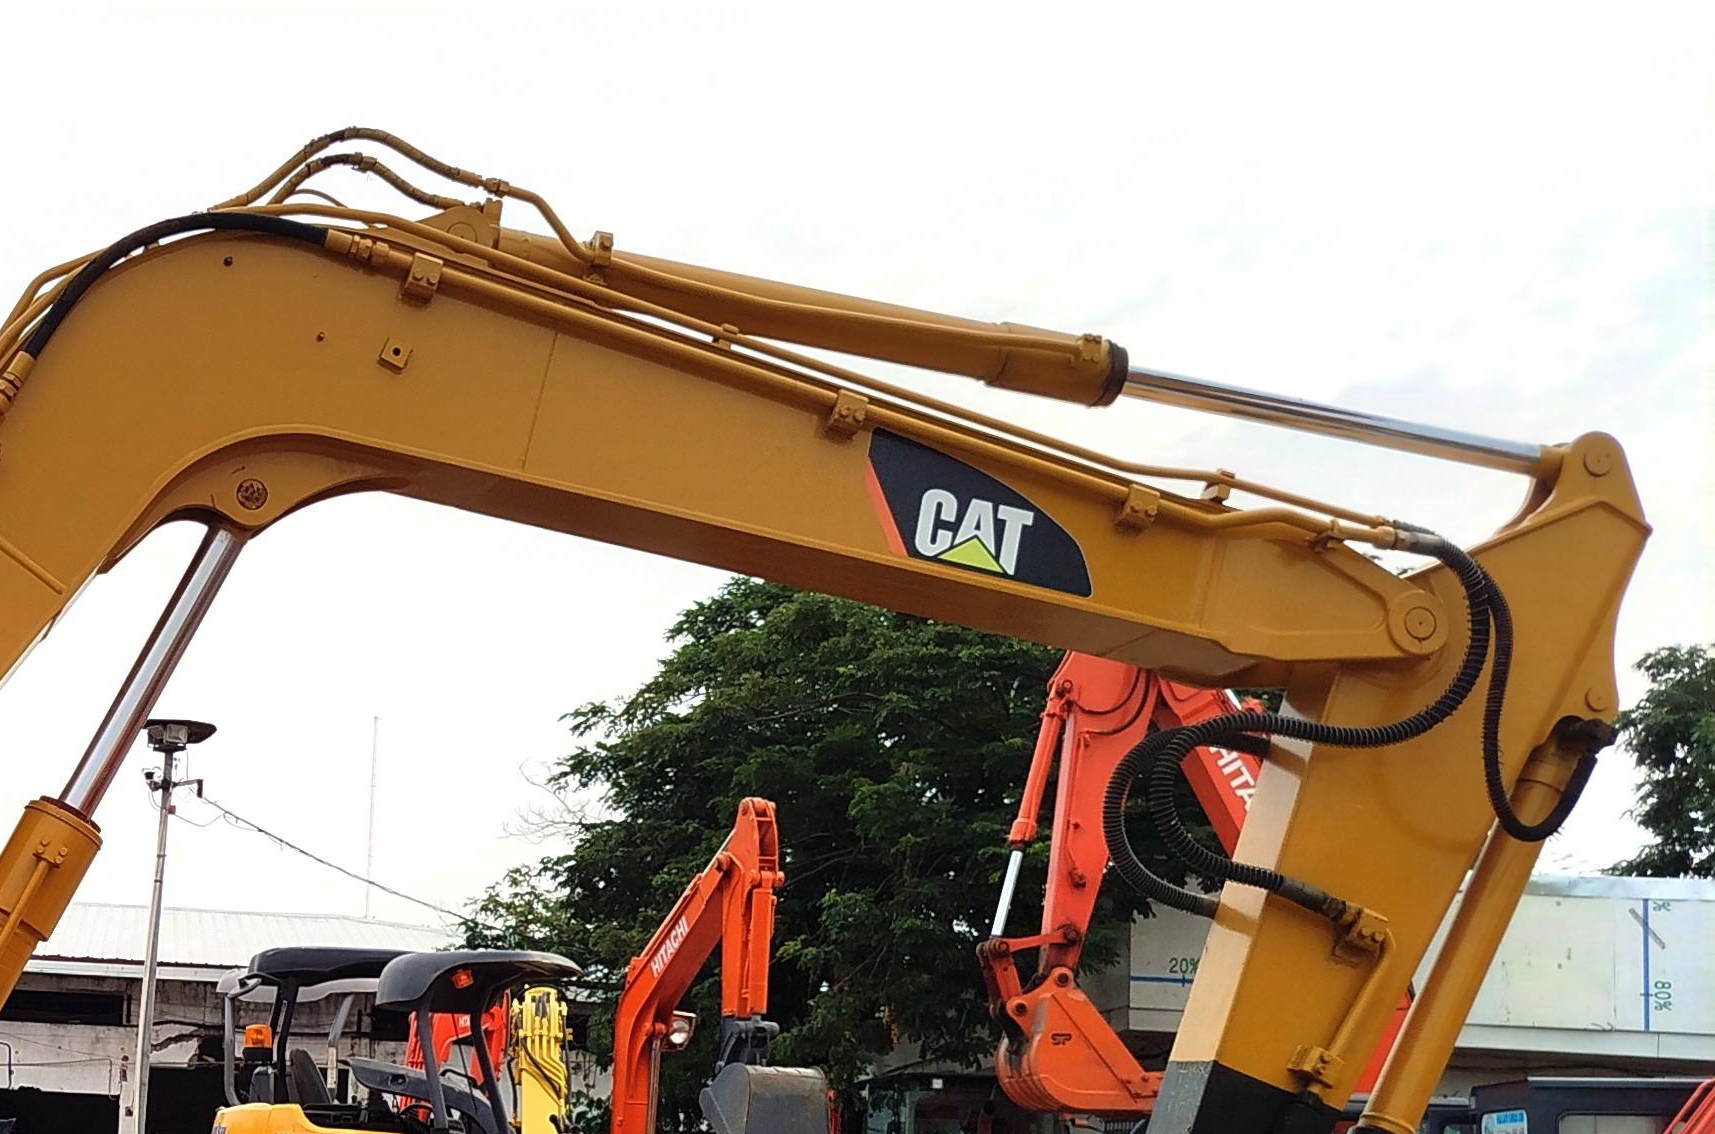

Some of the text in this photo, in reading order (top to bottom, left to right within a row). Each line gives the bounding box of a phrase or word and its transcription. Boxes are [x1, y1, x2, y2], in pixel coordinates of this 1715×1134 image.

[914, 488, 1035, 576] CAT
[650, 914, 690, 979] HITACHI
[1168, 957, 1201, 974] 20%
[1653, 980, 1672, 1012] 80%
